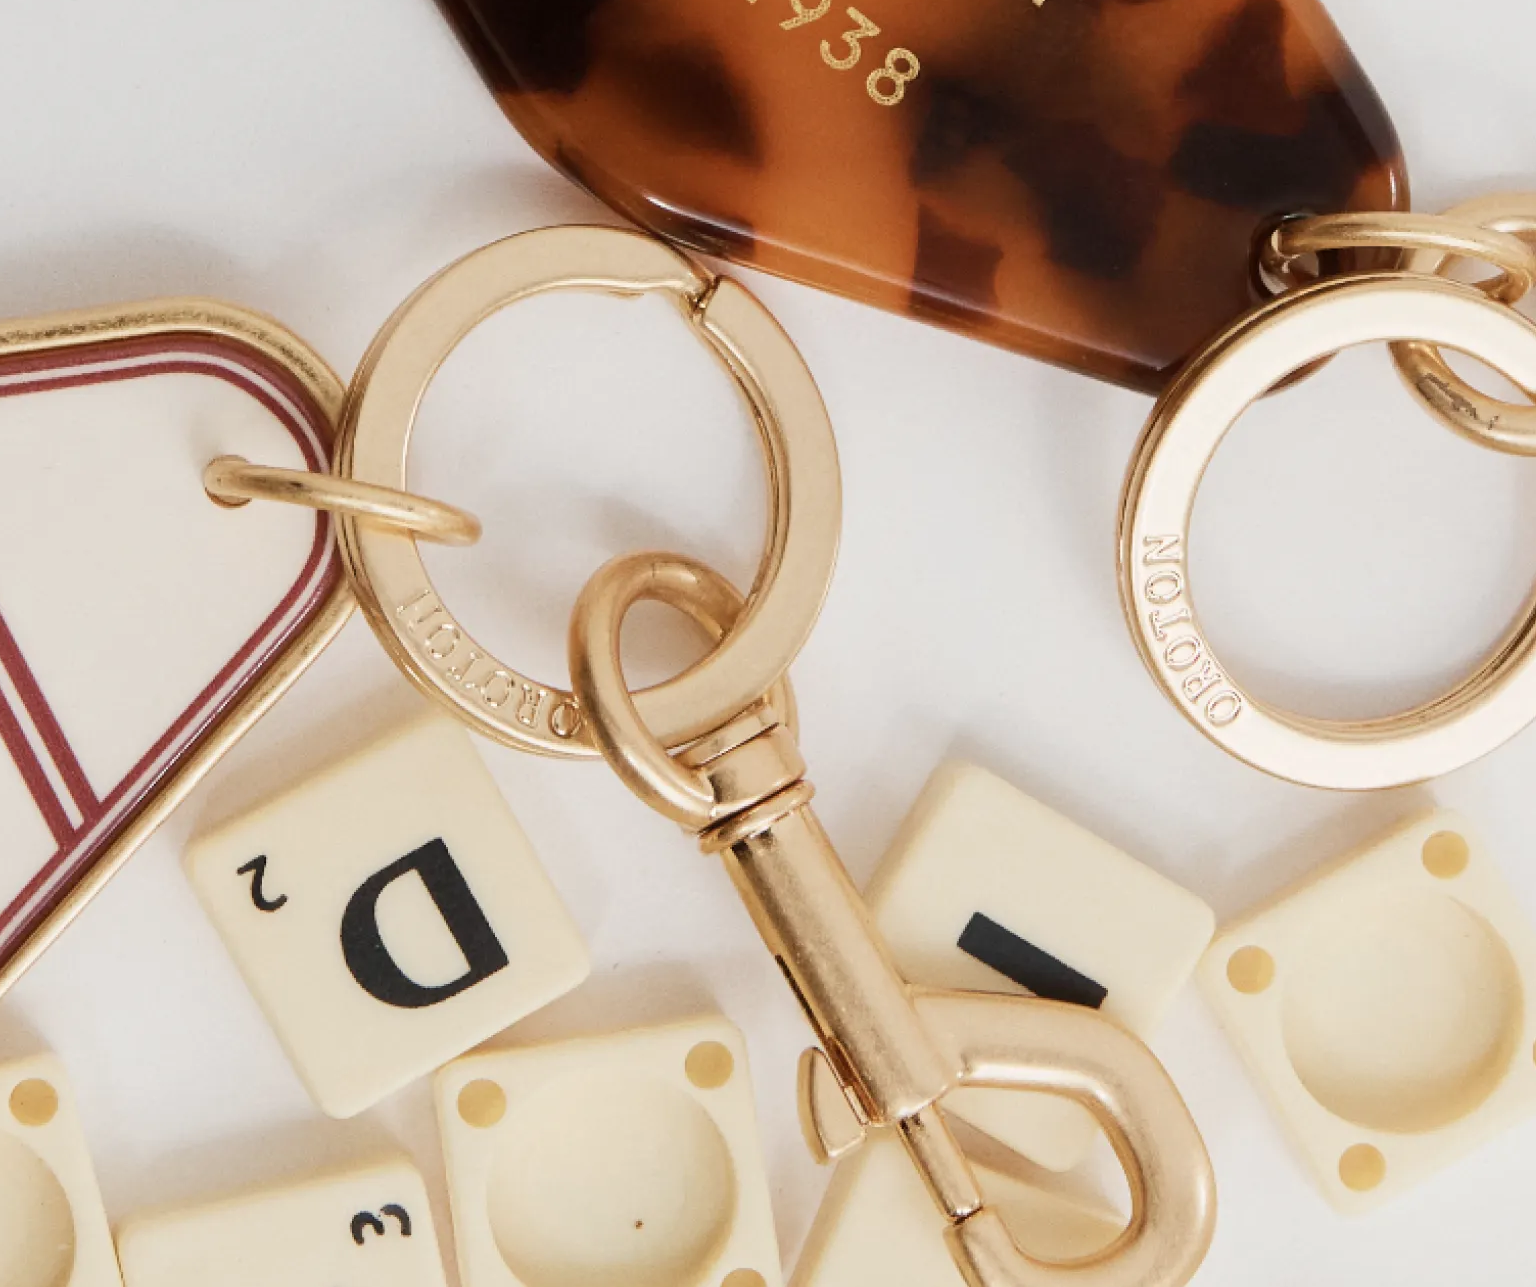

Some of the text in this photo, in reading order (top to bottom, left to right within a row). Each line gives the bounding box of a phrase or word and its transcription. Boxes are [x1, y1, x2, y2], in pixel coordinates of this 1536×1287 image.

[1142, 533, 1243, 727] OROTON
[236, 837, 510, 1009] D 2
